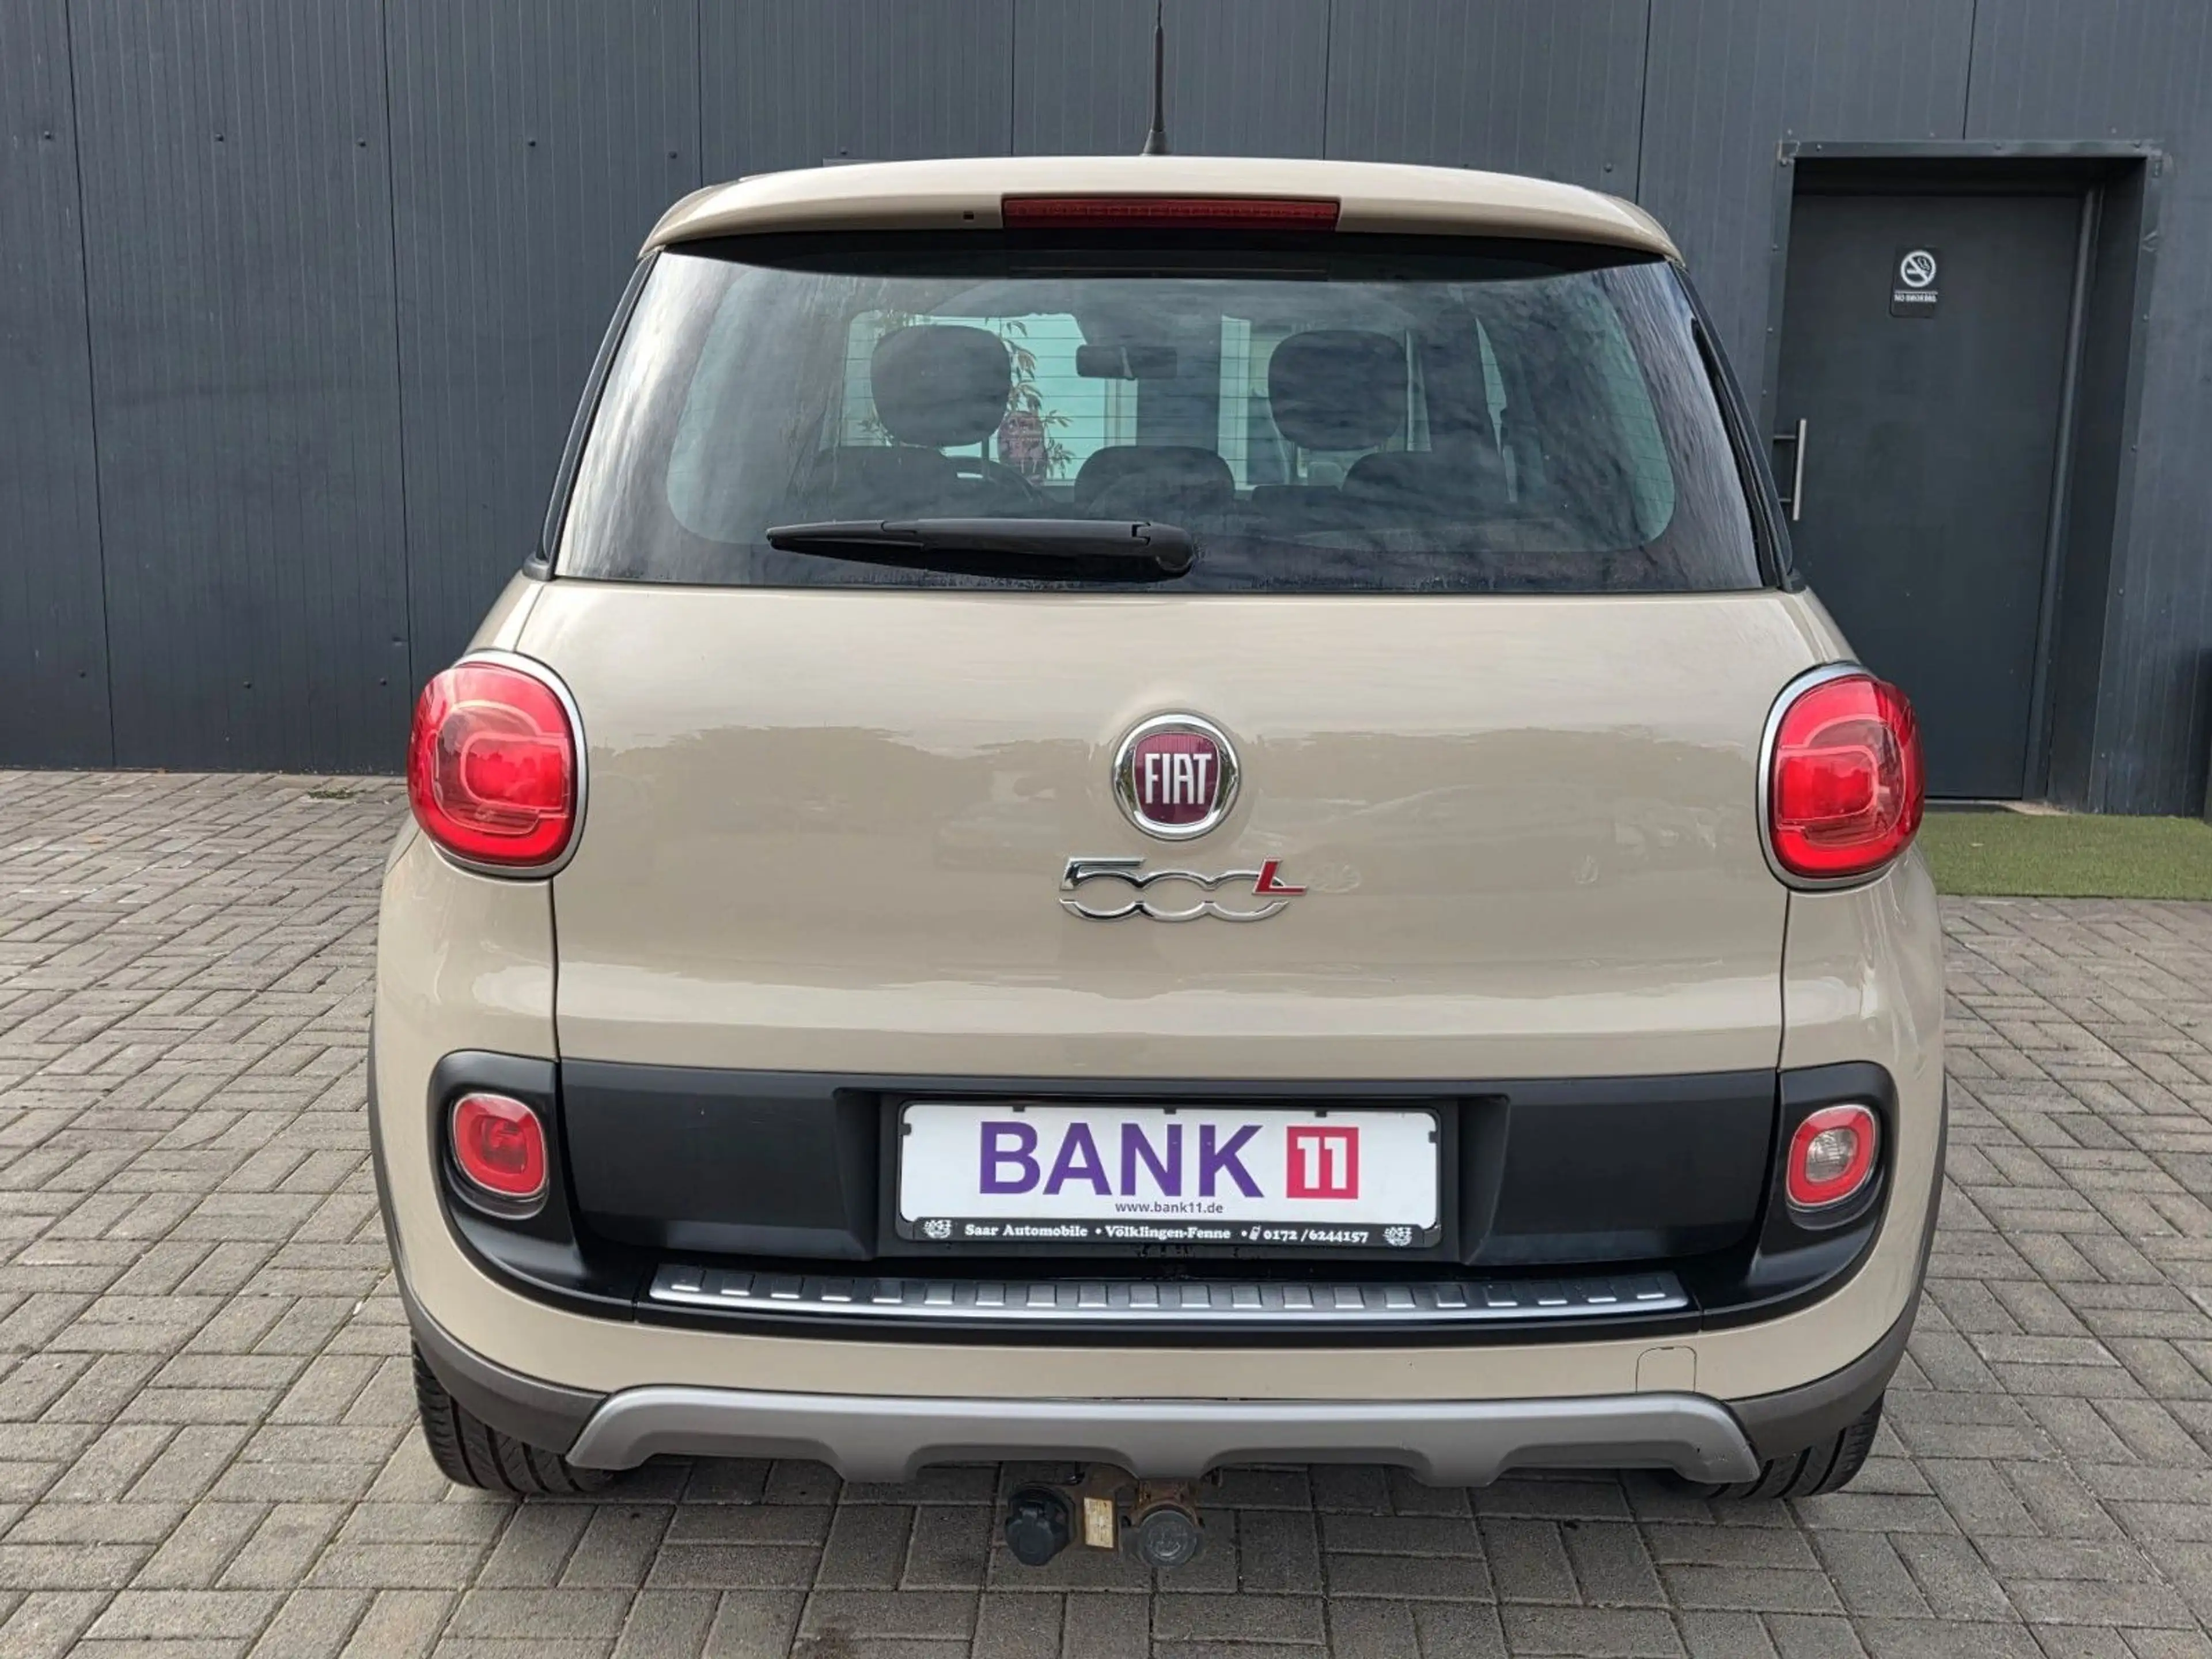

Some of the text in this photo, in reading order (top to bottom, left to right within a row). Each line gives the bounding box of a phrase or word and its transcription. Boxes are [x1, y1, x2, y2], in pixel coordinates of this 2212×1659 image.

[1145, 753, 1211, 804] FIAT
[1059, 855, 1308, 922] 500L
[979, 1120, 1349, 1198] BANK 11
[965, 1224, 999, 1236] Saar
[1002, 1224, 1088, 1237] Automobile
[1105, 1225, 1231, 1240] Völklingen-Fenne
[1263, 1230, 1297, 1242] 0172
[1115, 1201, 1224, 1214] www.bank11.de
